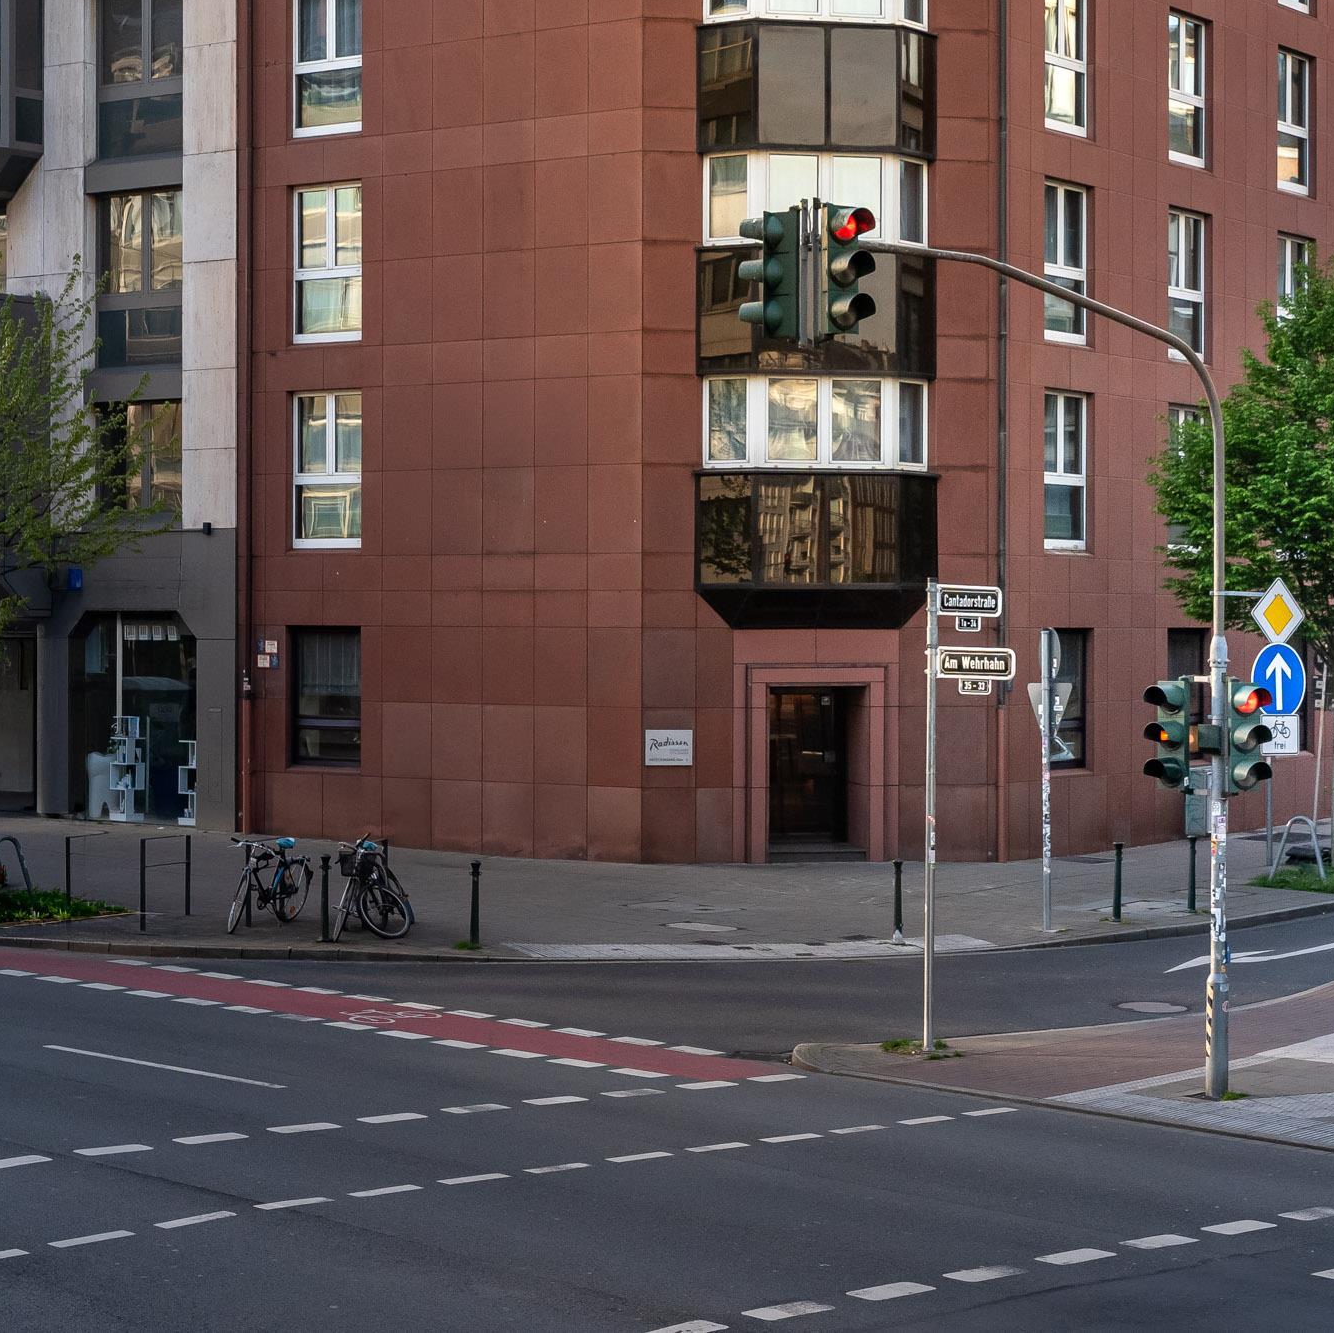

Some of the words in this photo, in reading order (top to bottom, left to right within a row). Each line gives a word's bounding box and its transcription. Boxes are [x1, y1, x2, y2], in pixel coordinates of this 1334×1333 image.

[943, 594, 996, 608] Cantadorstraße
[944, 655, 958, 669] Am
[961, 655, 1005, 670] Wehrhahn
[964, 681, 972, 690] 35
[977, 681, 985, 690] 33
[649, 736, 689, 751] Radisson
[1274, 740, 1287, 750] frei
